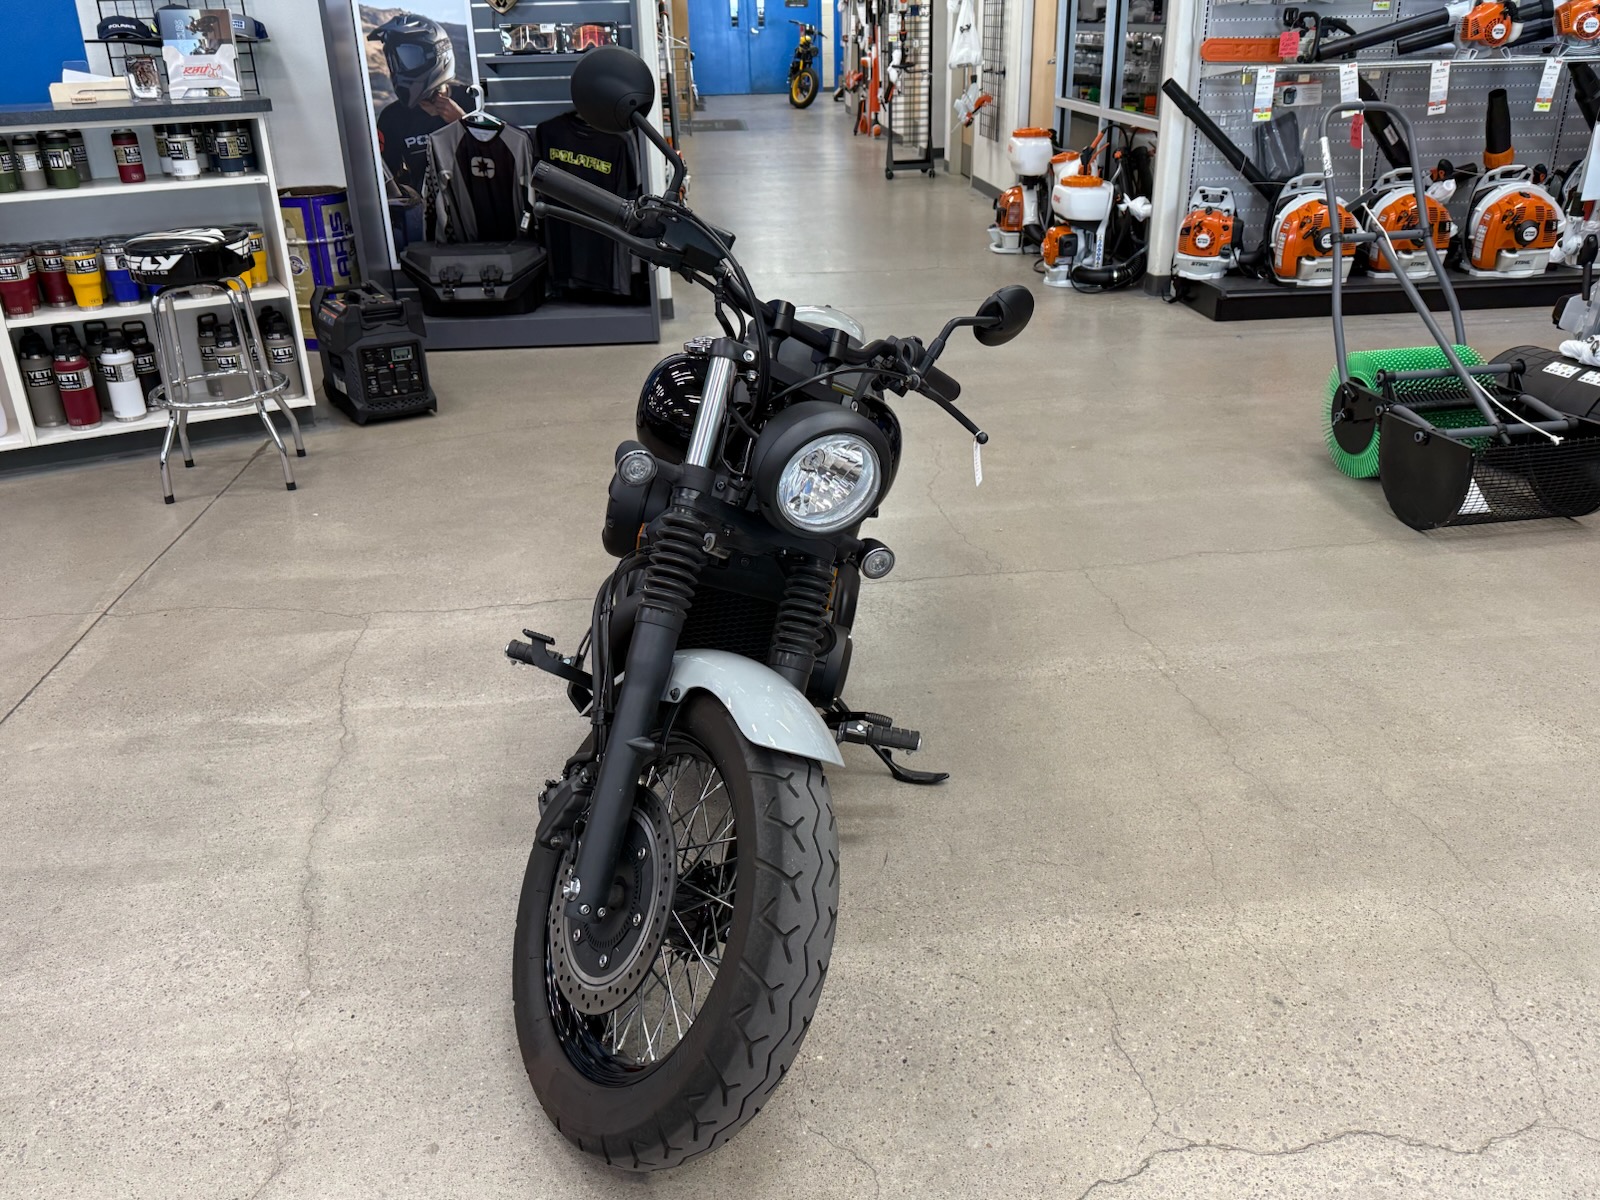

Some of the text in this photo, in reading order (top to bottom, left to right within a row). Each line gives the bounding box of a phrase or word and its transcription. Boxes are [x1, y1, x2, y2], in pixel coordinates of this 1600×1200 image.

[549, 147, 612, 175] POLARIS
[44, 257, 61, 265] YET
[76, 258, 96, 267] YETI
[272, 347, 292, 356] YETI
[28, 368, 51, 379] YETI
